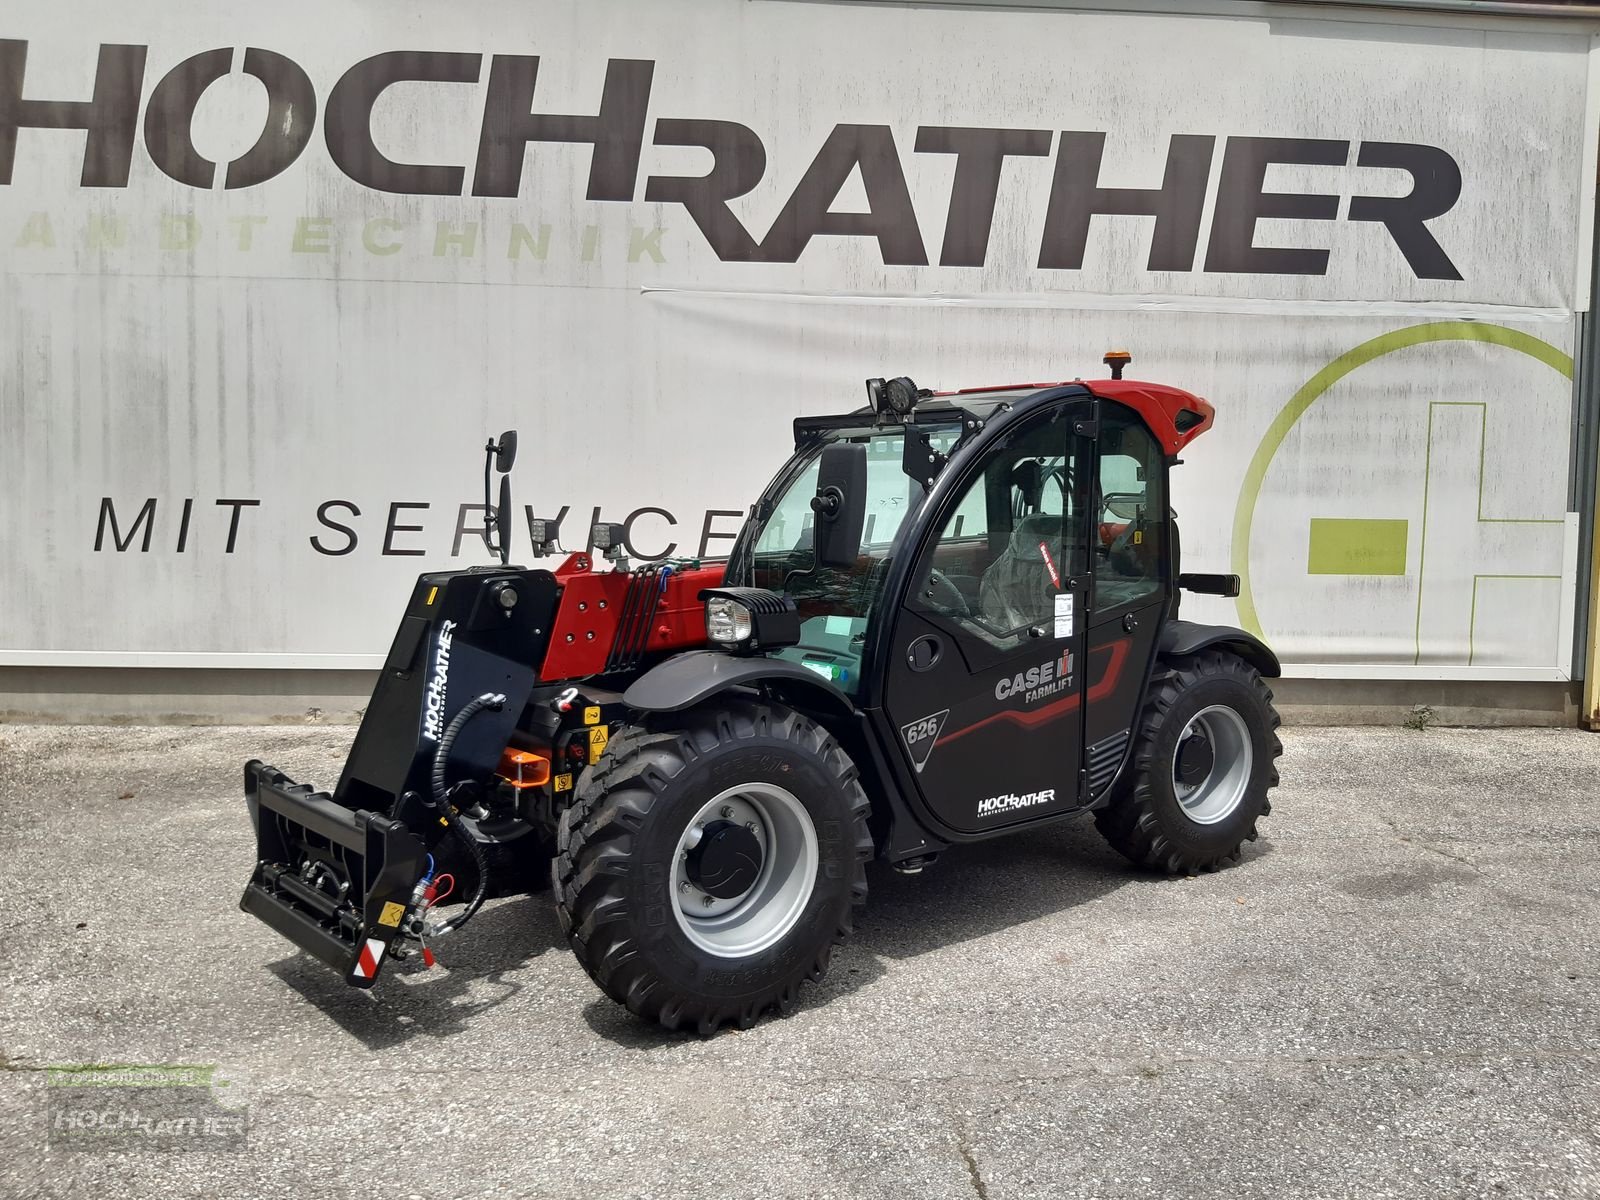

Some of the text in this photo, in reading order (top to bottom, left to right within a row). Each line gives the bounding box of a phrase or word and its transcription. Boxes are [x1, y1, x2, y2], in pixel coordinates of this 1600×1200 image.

[0, 38, 1465, 281] HOCHRATHER
[93, 496, 261, 554] MIT
[310, 499, 745, 561] SERVICE
[424, 620, 457, 741] HOCHRATHER
[995, 660, 1054, 700] CASE
[1025, 676, 1074, 703] FARMLIFT
[907, 717, 938, 744] 626
[978, 789, 1056, 813] HOCHRATHER
